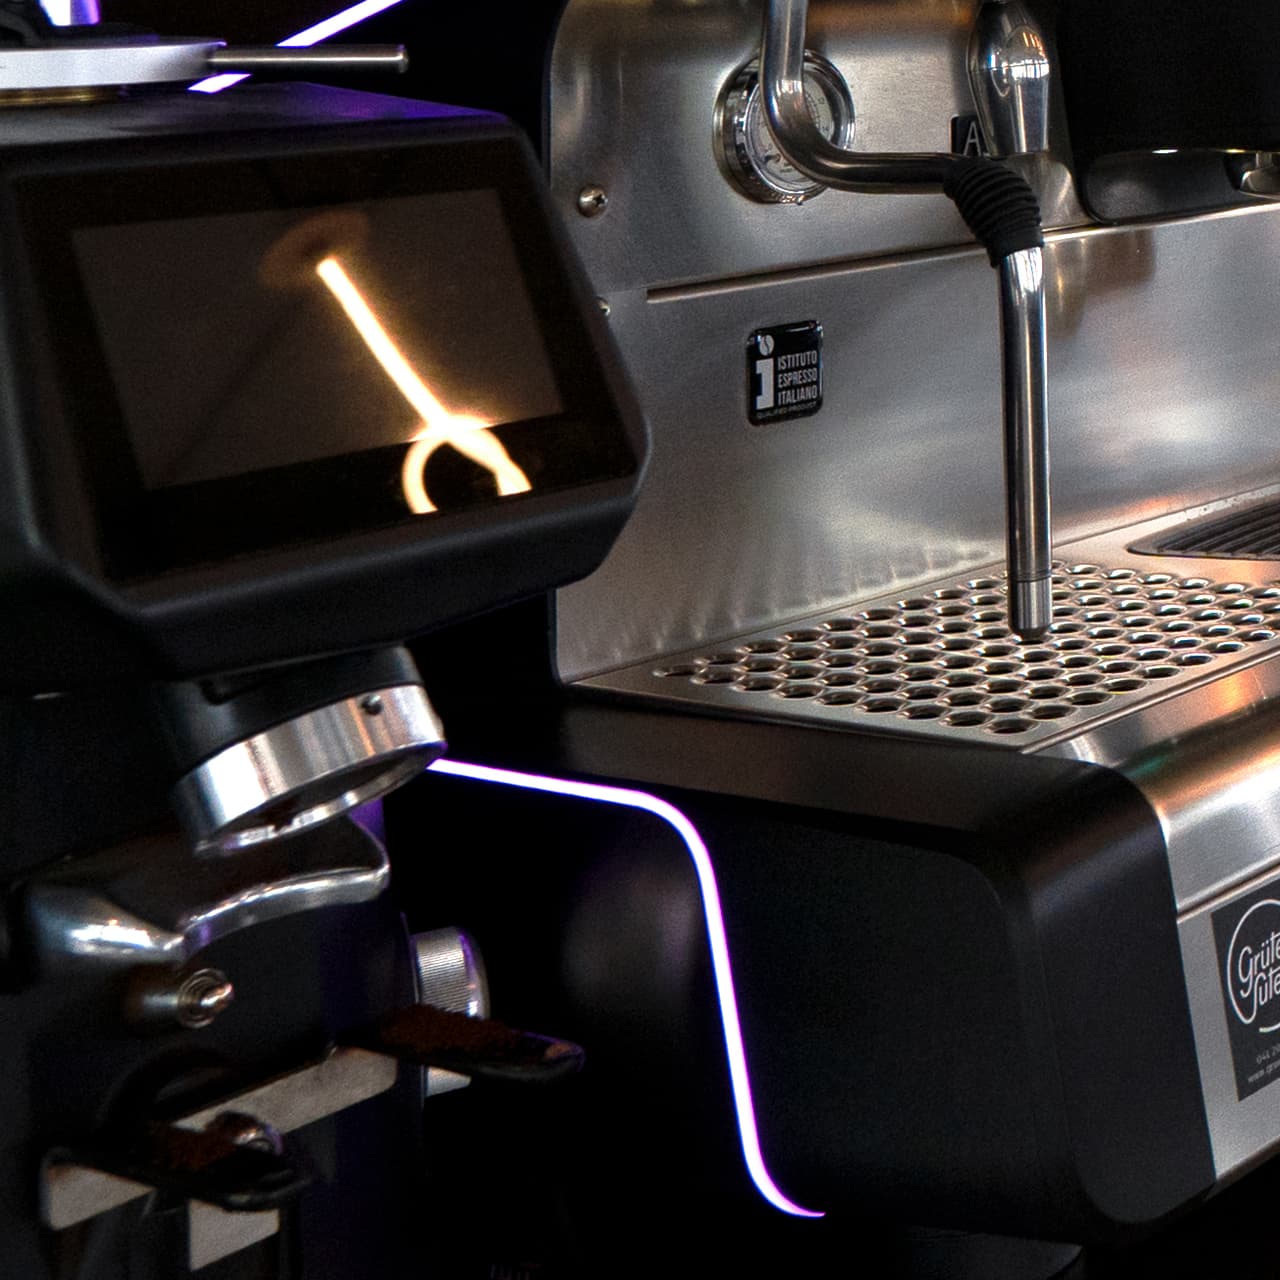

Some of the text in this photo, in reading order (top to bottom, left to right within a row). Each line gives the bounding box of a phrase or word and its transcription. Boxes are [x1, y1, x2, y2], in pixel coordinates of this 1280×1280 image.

[777, 350, 818, 371] ISTITUTO
[777, 367, 818, 389] ESPRESSO
[777, 384, 818, 406] ITALIANO
